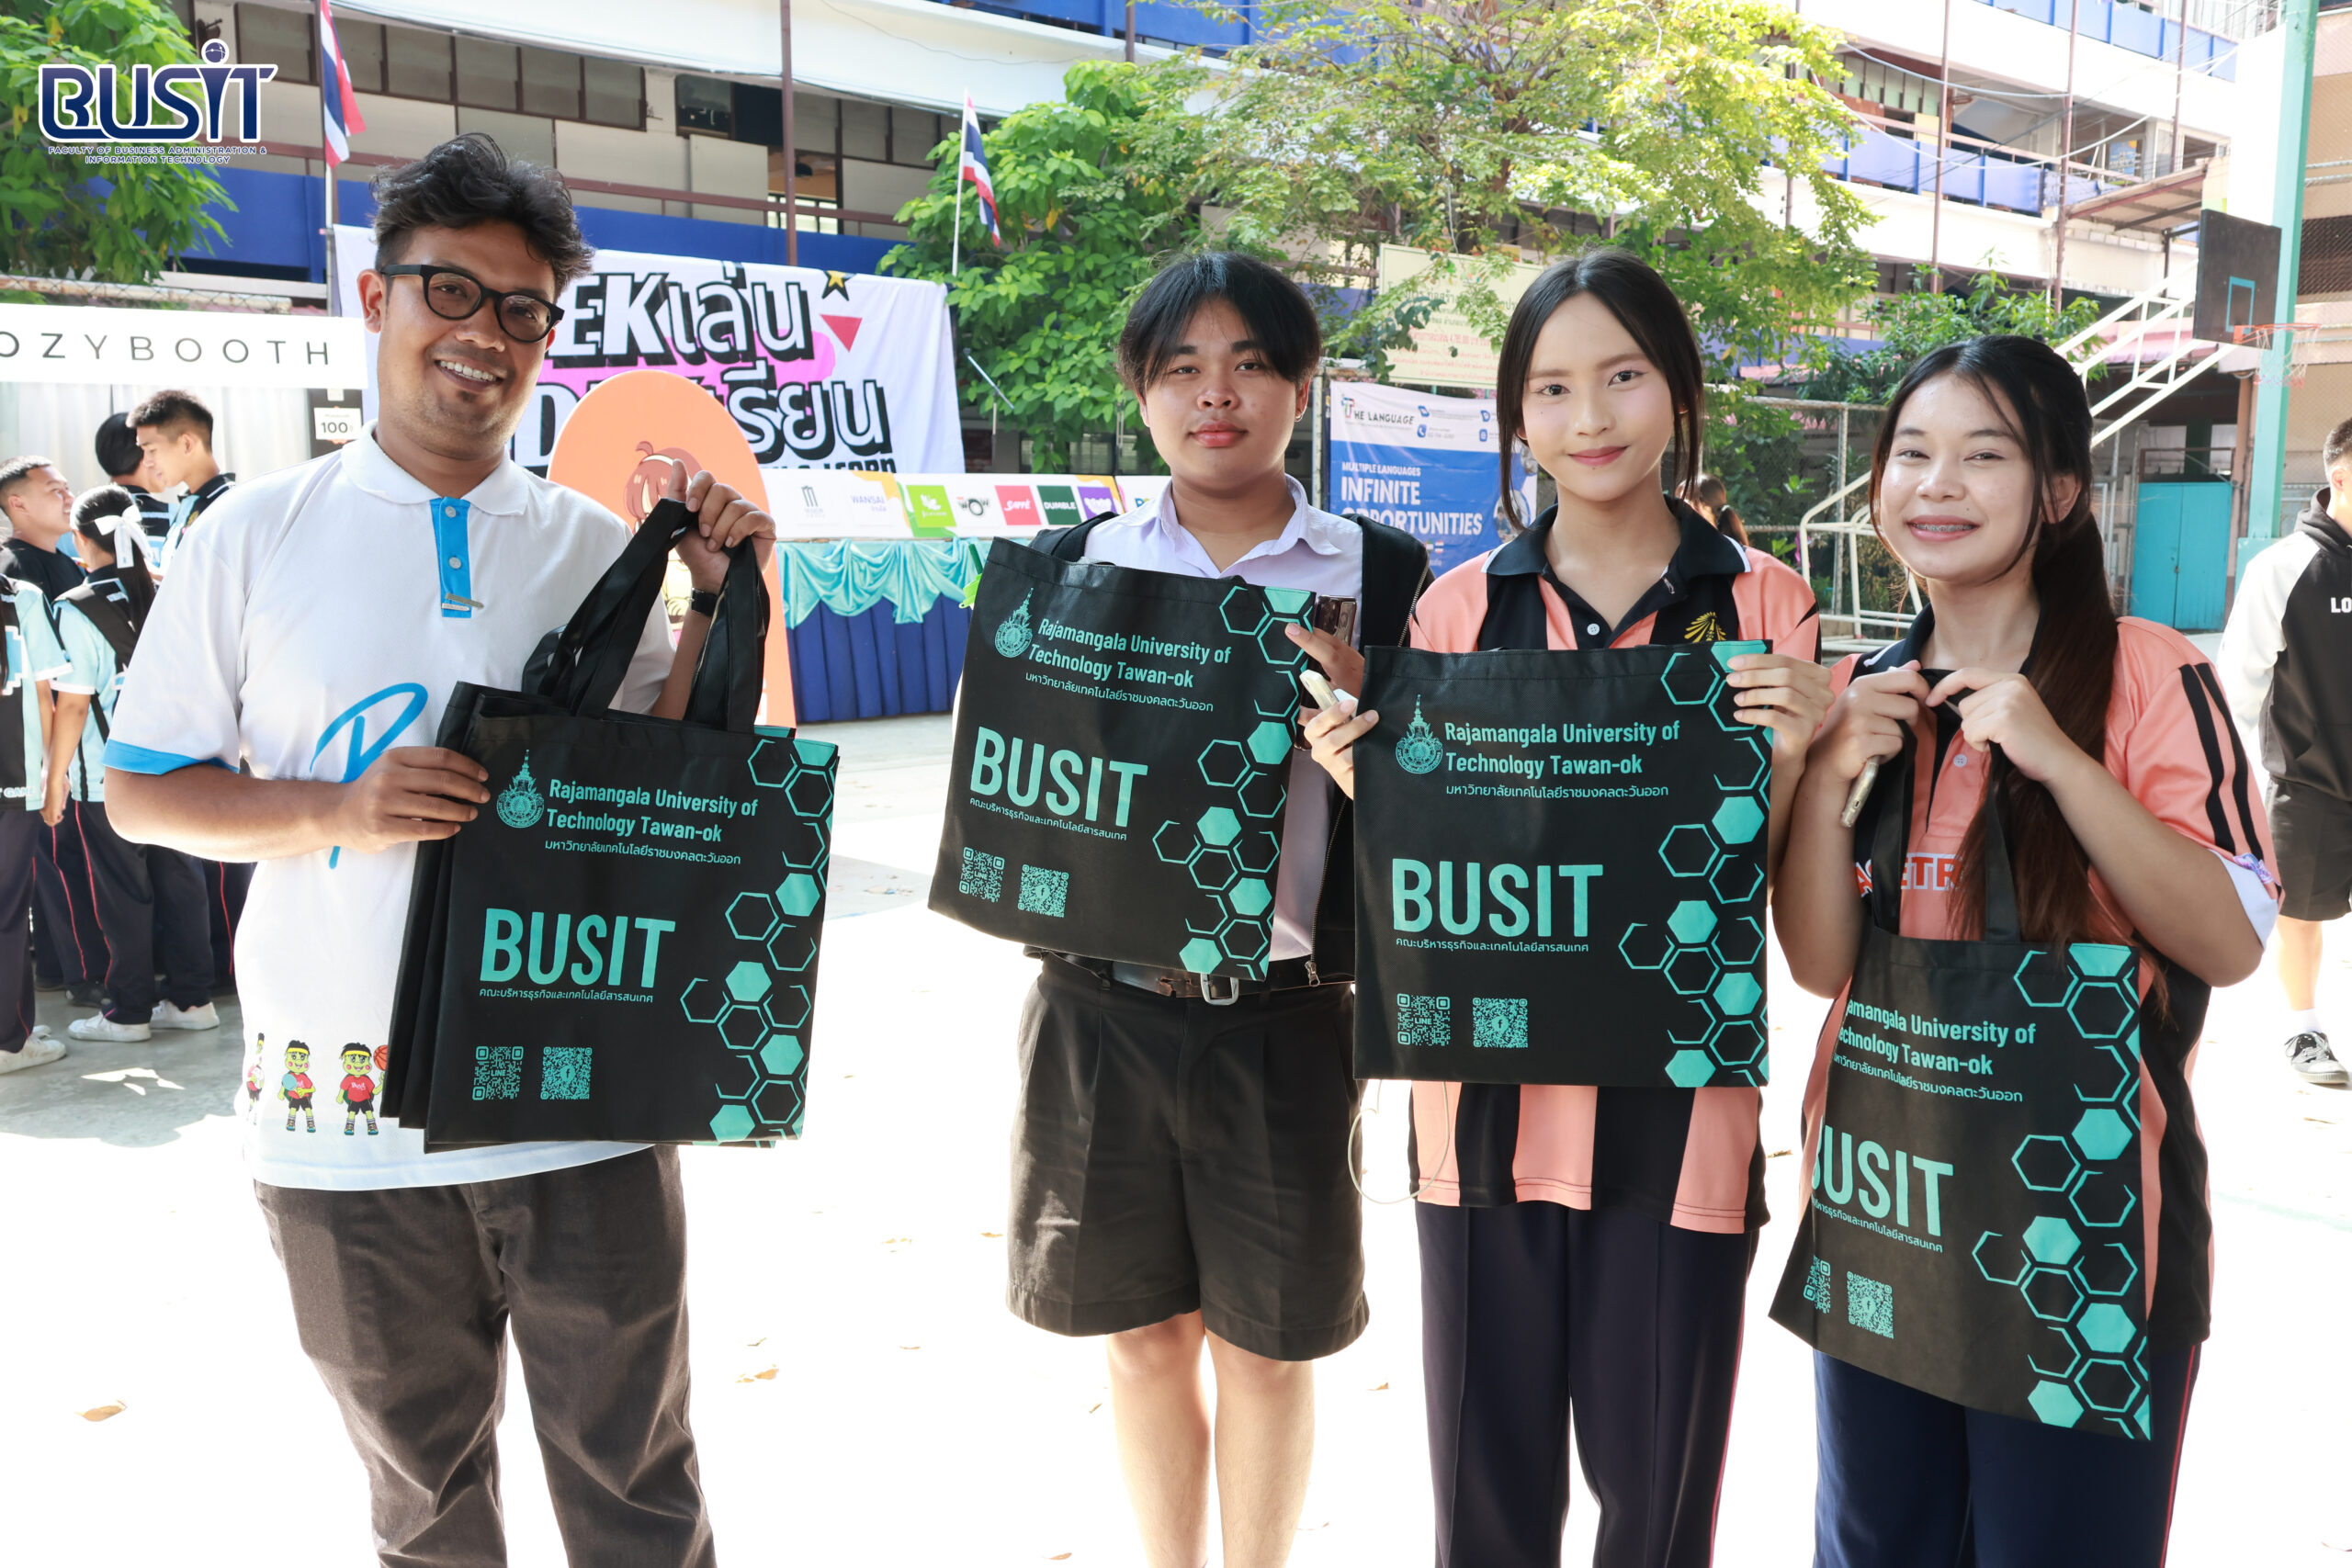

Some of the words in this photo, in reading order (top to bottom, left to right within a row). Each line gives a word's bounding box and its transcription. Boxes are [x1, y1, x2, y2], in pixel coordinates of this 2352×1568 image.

[321, 422, 348, 434] 100
[1368, 412, 1416, 425] LANGUAGE
[1341, 461, 1377, 474] MULTIPLE
[1377, 464, 1422, 477] LANGUAGES
[1341, 476, 1421, 505] INFINITE
[1037, 618, 1127, 652] Rajamangala
[1130, 634, 1211, 665] University
[1214, 646, 1232, 664] of
[1028, 643, 1113, 682] Technology
[1116, 660, 1195, 688] Tawan-ok
[1024, 671, 1215, 713] มหาวิทยาลัยเทคโนโลยีราชมงคลตะวันออก
[1444, 722, 1557, 749] Rajamangala
[1562, 721, 1657, 746] University
[1661, 720, 1680, 740] of
[970, 726, 1148, 828] BUSIT
[1445, 752, 1545, 780] Technology
[1550, 753, 1643, 775] Tawan-ok
[548, 779, 650, 807] Rajamangala
[655, 789, 738, 818] University
[741, 799, 759, 817] of
[1445, 784, 1669, 799] มหาวิทยาลัยเทคโนโลยีราชมงคลตะวันออก
[547, 808, 636, 837] Technology
[640, 816, 723, 842] Tawan-ok
[545, 840, 741, 865] มหาวิทยาลัยเทคโนโลยีราชมงคลตะวันออก
[1392, 858, 1604, 938] BUSIT
[480, 908, 676, 988] BUSIT
[1396, 937, 1589, 953] คณะบริหารธุรกิจและเทคโนโลยีสารสนเทศ
[479, 987, 654, 1003] คณะบริหารธุรกิจและเทคโนโลยีสารสนเทศ
[1847, 998, 1907, 1032] amangala
[1910, 1014, 2009, 1048] University
[2014, 1022, 2037, 1044] of
[1838, 1026, 1899, 1064] echnology
[1901, 1043, 1994, 1076] Tawan-ok
[1812, 1116, 1954, 1237] USIT
